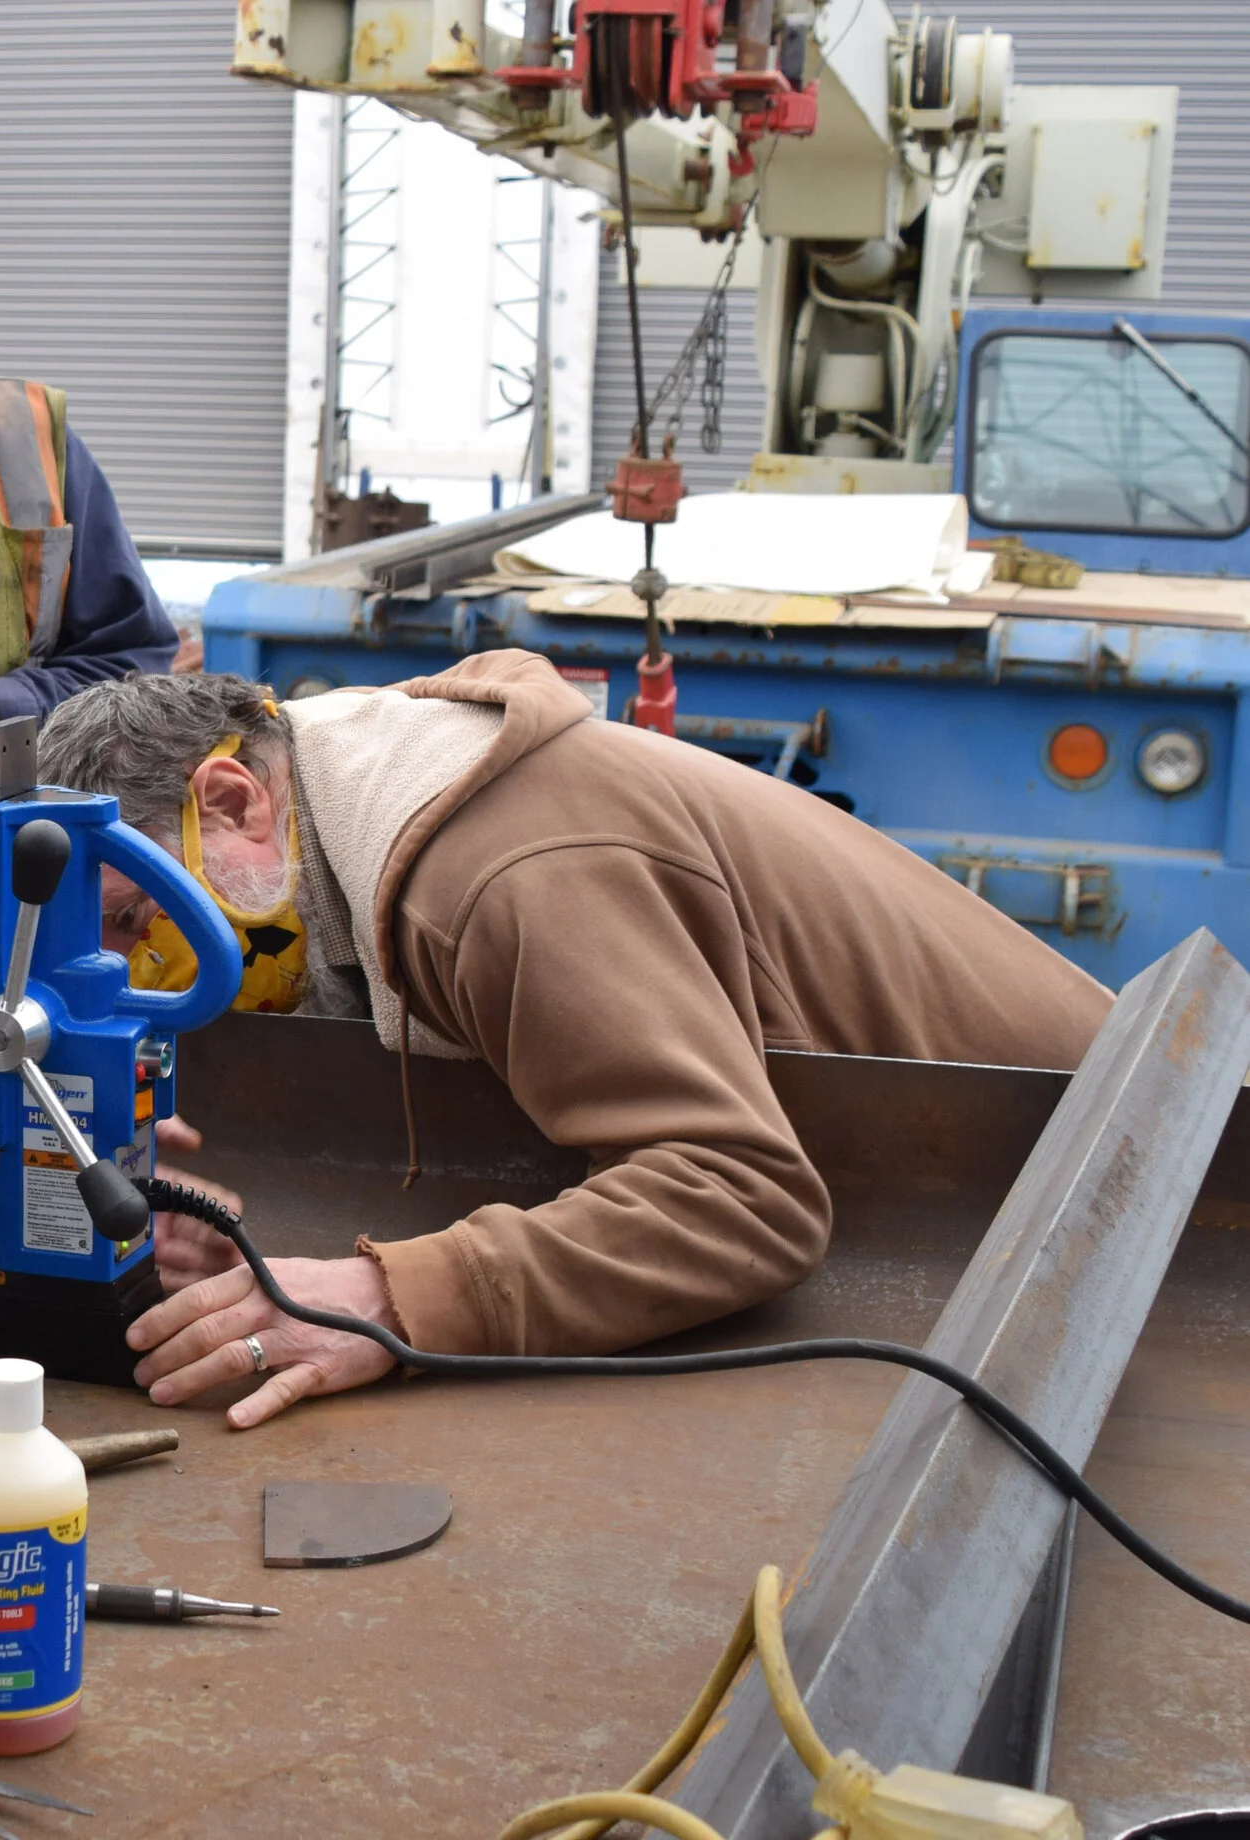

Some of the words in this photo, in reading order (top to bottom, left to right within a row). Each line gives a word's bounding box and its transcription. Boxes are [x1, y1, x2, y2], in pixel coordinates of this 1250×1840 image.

[28, 1111, 88, 1129] HM04
[21, 1582, 45, 1597] Fluid
[2, 1607, 23, 1618] TOOLS
